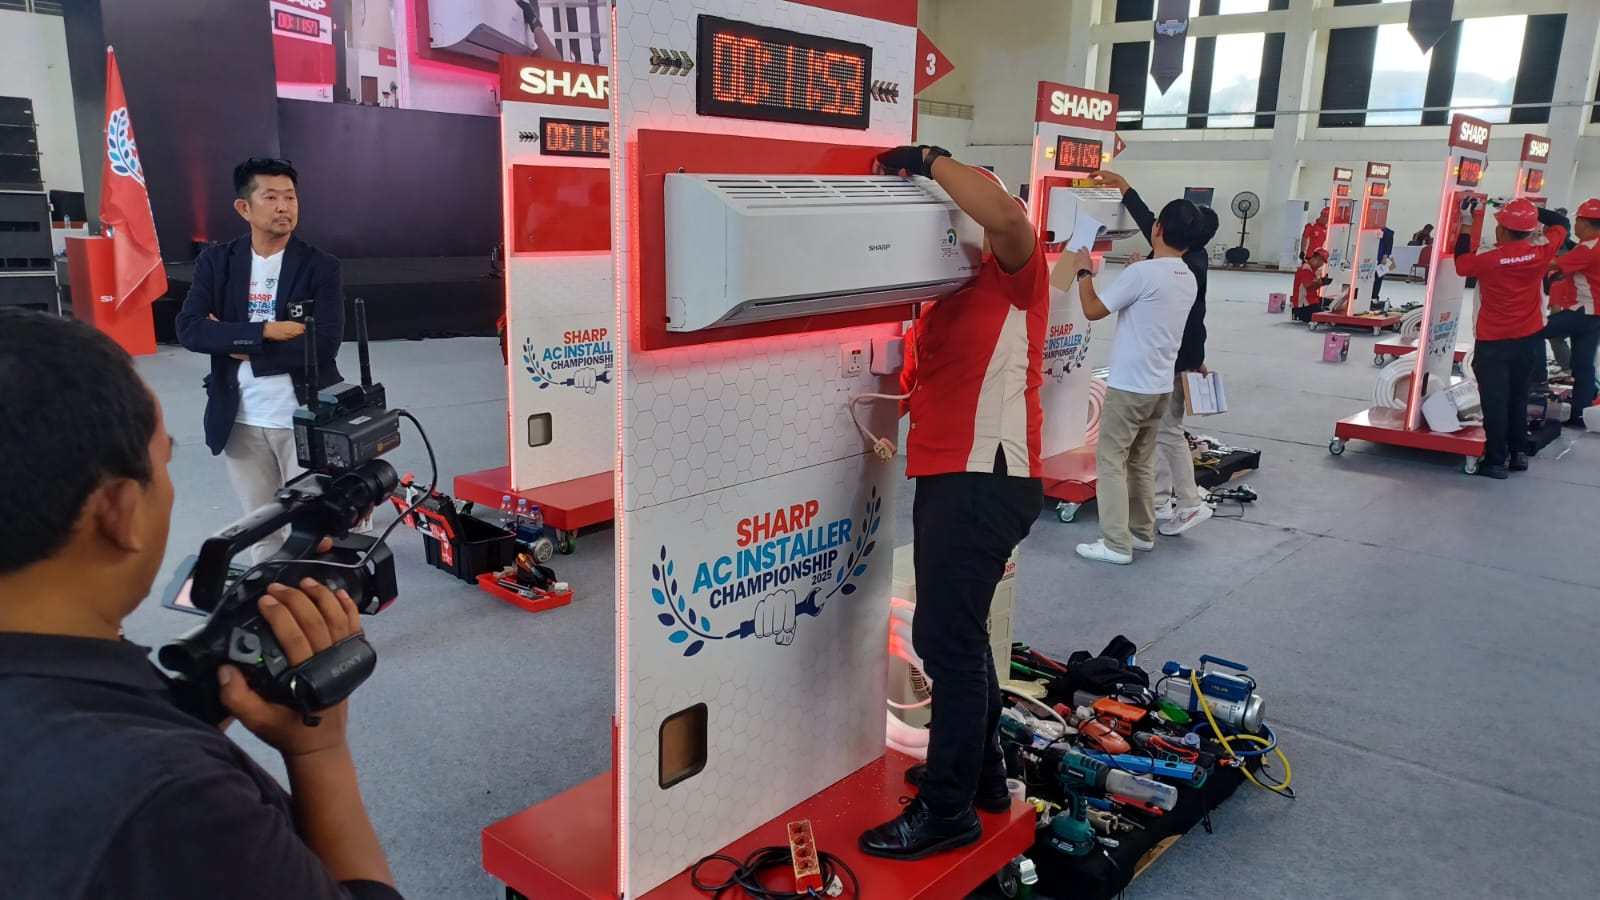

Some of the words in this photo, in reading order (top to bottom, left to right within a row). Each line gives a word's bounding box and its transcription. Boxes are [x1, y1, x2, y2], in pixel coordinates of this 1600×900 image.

[713, 33, 864, 116] 00:11:53
[926, 53, 937, 76] 3
[519, 66, 609, 100] SHAR
[1050, 91, 1112, 121] SHARP
[1460, 122, 1487, 144] SHARP
[1529, 140, 1549, 157] SHARP
[868, 243, 892, 252] SHARP
[1500, 254, 1535, 264] SHARP
[564, 328, 607, 344] SHARP
[1050, 323, 1073, 337] SHARP
[542, 346, 563, 362] AC
[564, 341, 613, 359] INSTALL
[1049, 334, 1082, 349] INSTALLER
[551, 355, 613, 370] CHAMPIONSHI
[736, 500, 820, 548] SHARP
[692, 555, 733, 595] AC
[736, 517, 853, 580] INSTALLER
[709, 549, 839, 610] CHAMPIONSHIP
[811, 570, 833, 586] 2025
[331, 653, 362, 678] SONY
